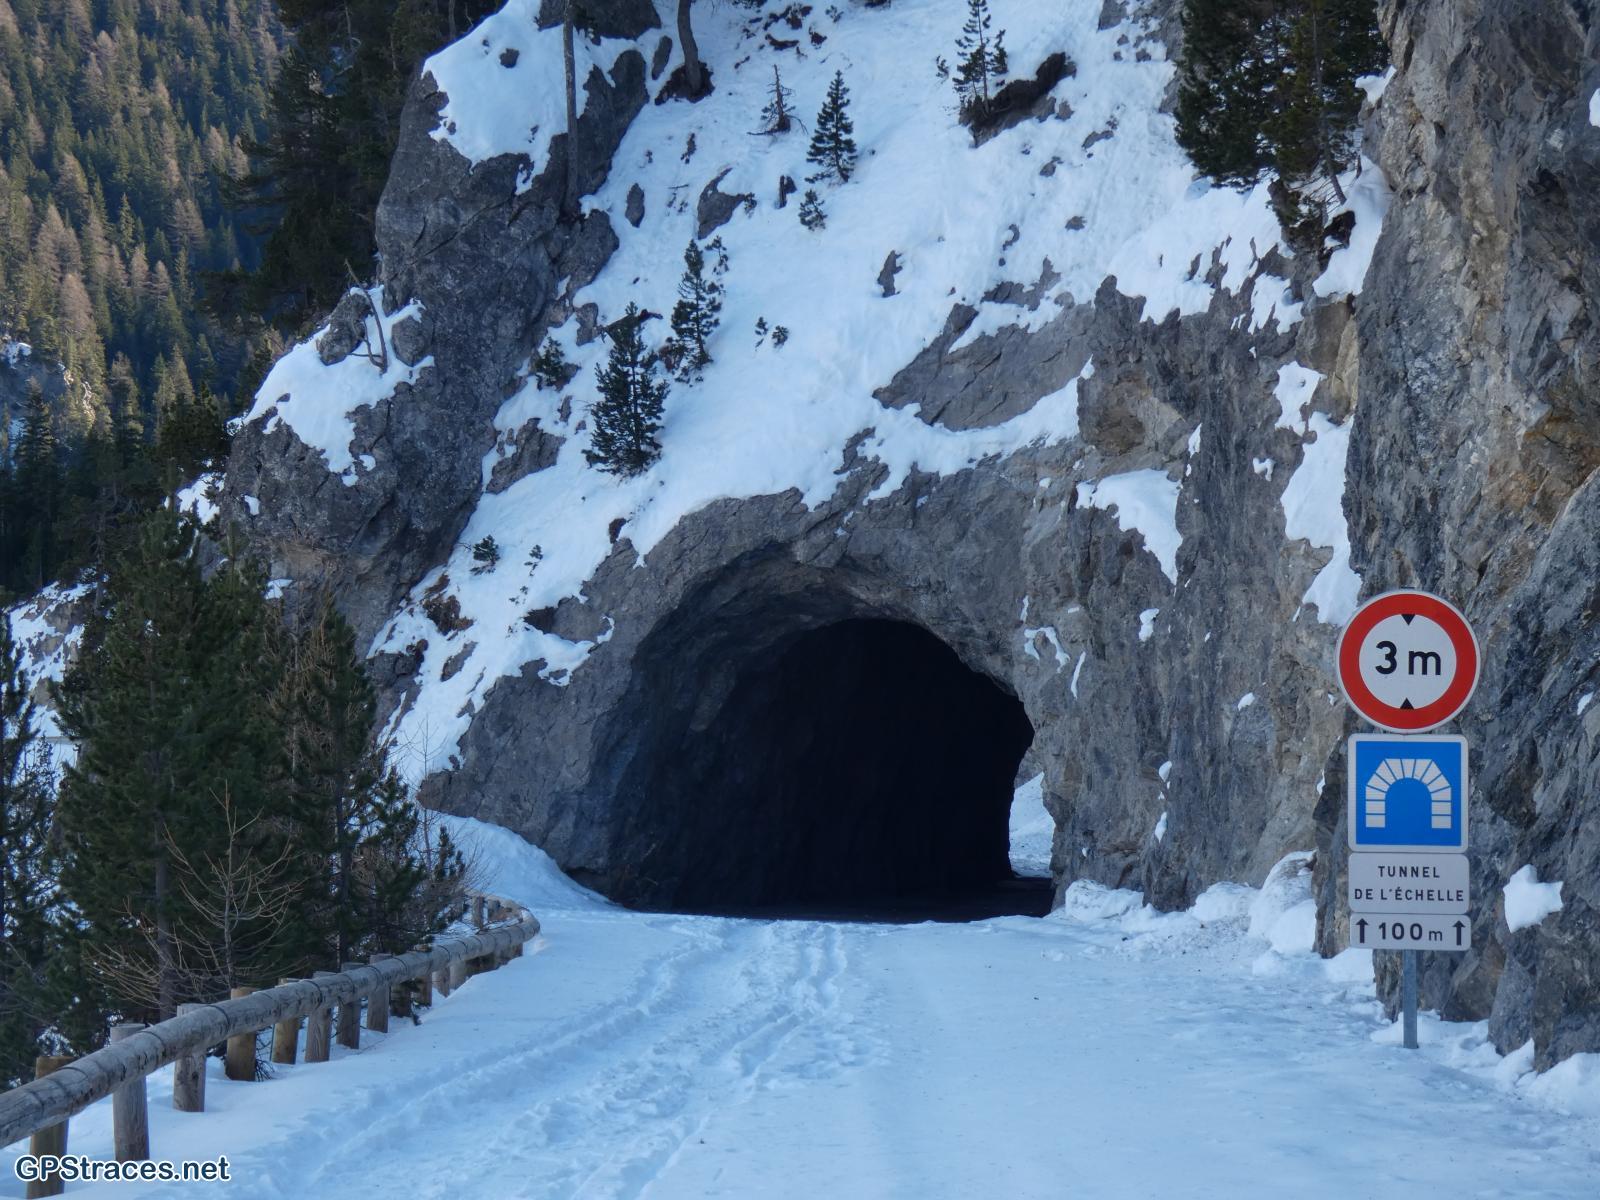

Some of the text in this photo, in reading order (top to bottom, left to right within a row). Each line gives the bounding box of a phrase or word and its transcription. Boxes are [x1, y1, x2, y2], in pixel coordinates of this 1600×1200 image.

[1375, 640, 1442, 676] 3 m
[1378, 865, 1440, 878] TUNNEL
[1354, 886, 1464, 902] DE L'ÉCHELLE
[1378, 921, 1443, 941] 100 m
